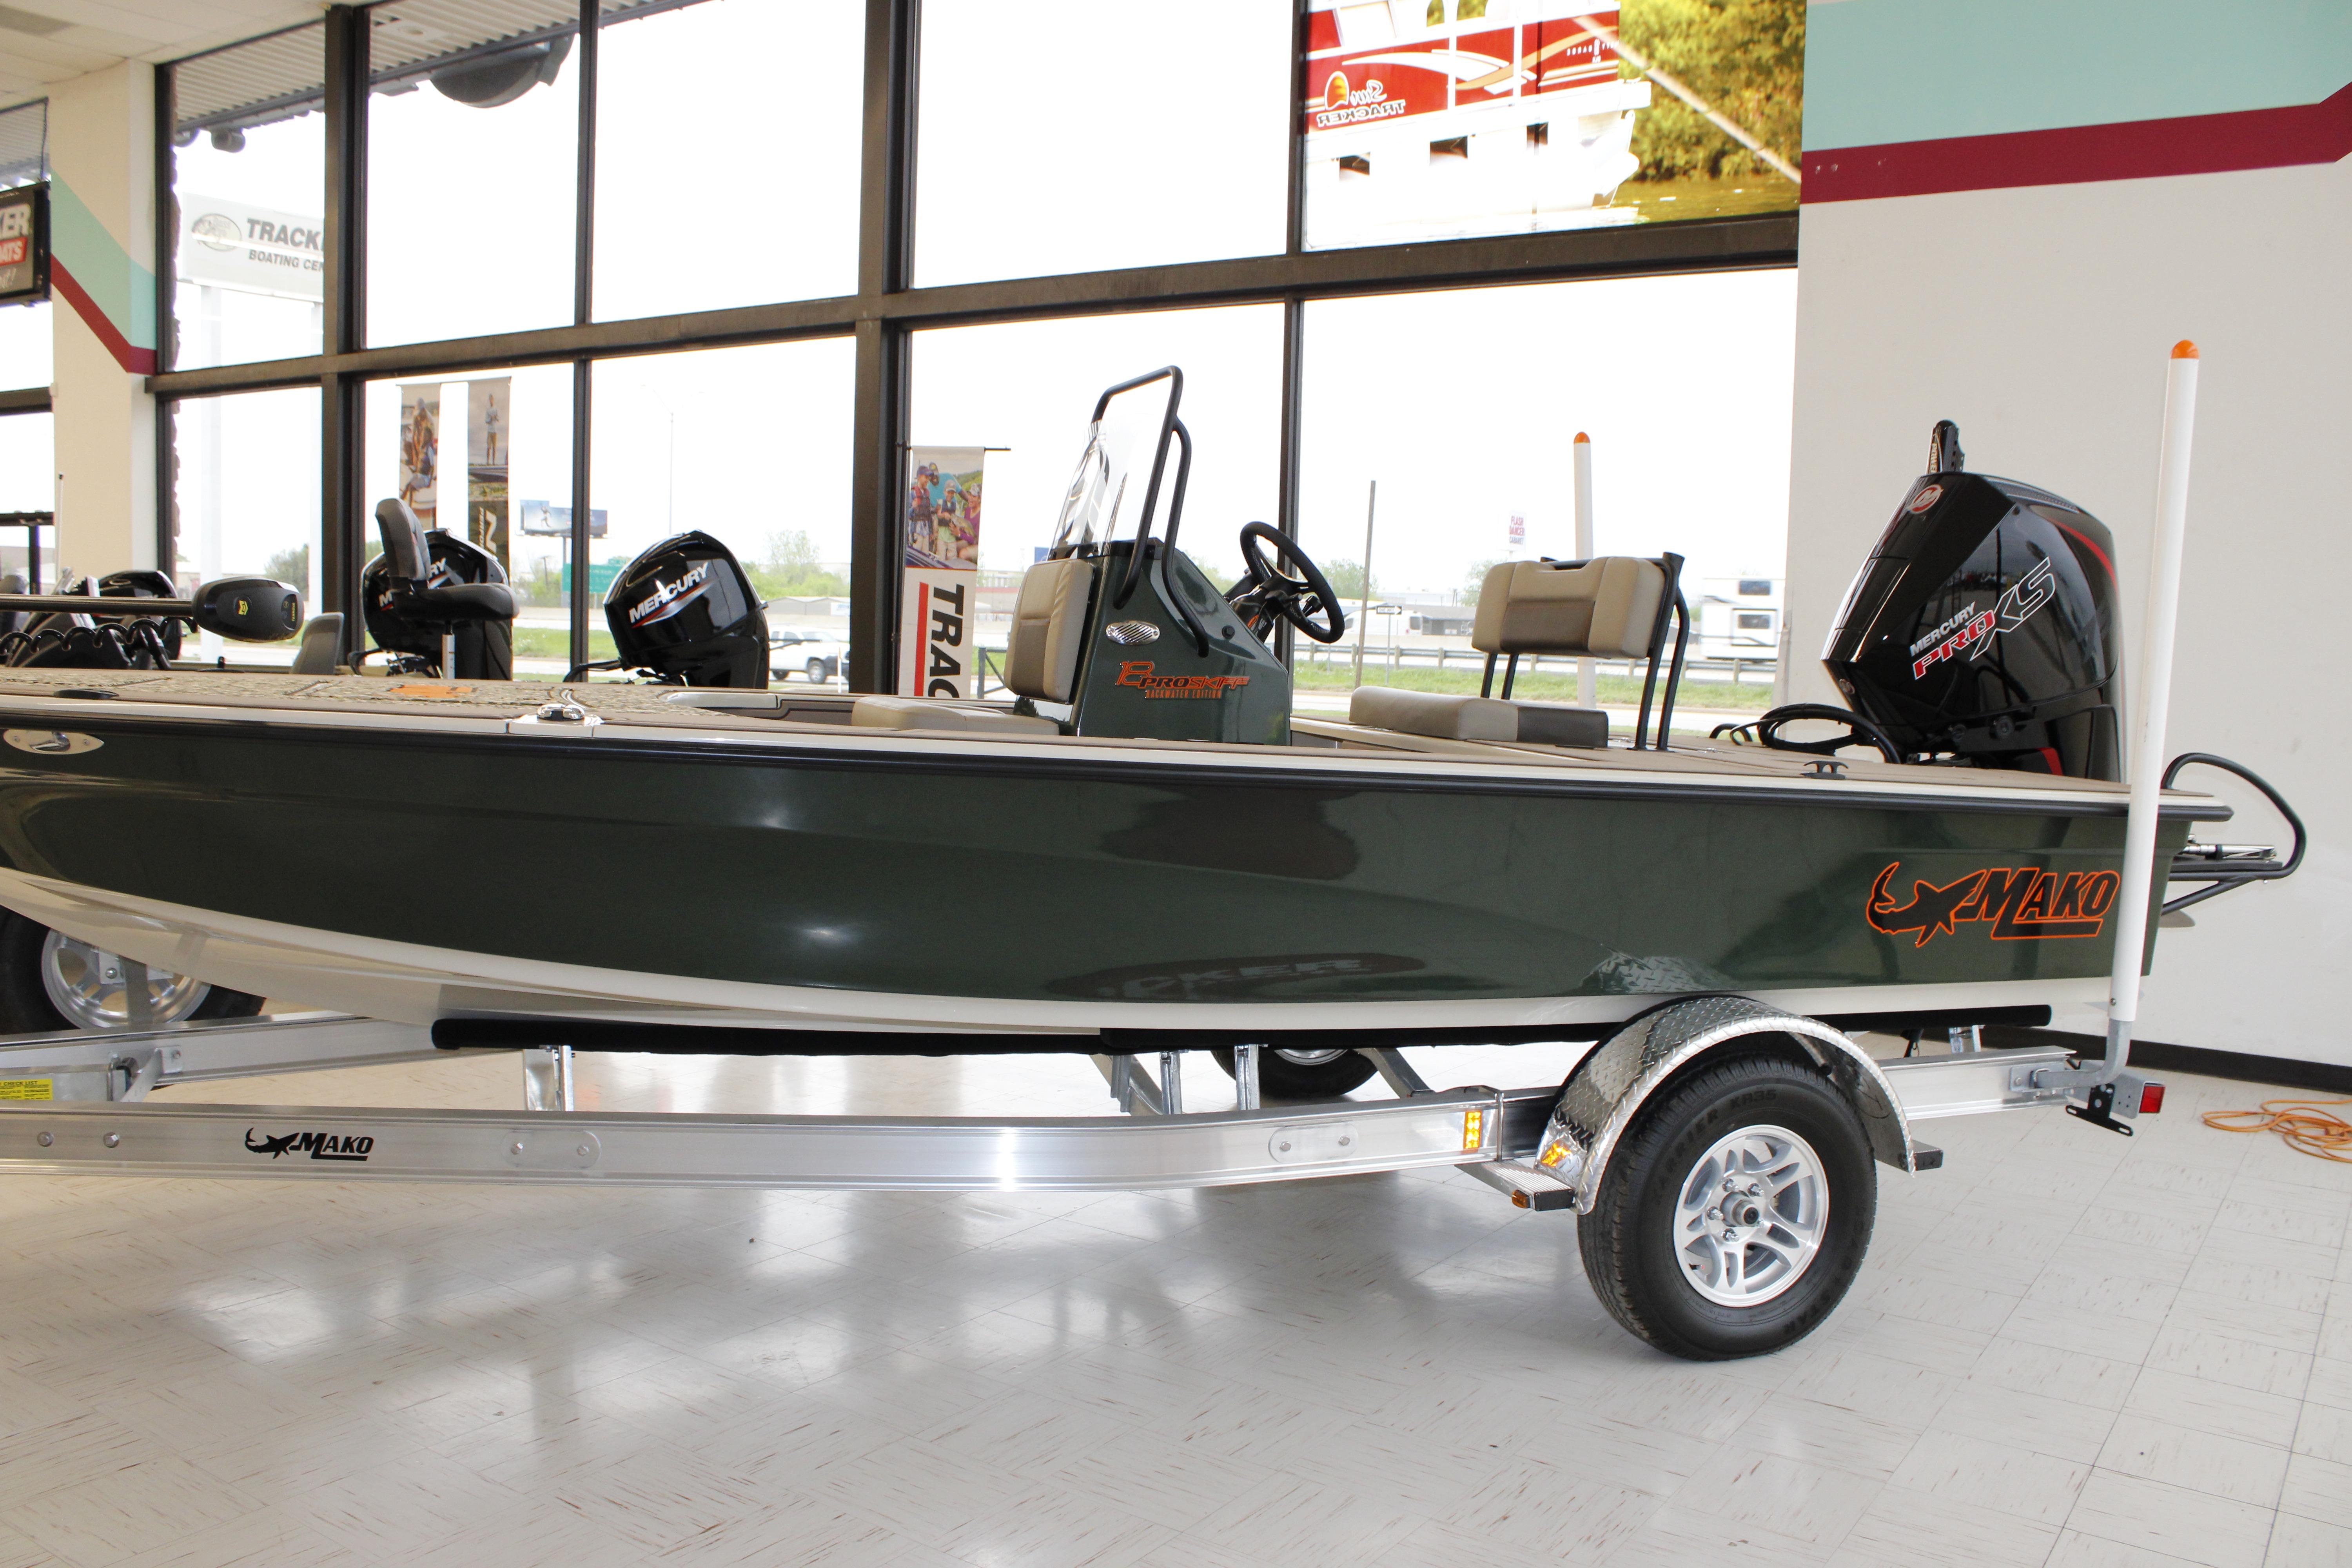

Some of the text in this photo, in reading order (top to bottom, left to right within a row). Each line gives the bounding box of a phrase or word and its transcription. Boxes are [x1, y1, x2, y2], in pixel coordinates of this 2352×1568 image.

[0, 204, 31, 238] ER
[247, 218, 324, 251] TRACK
[249, 250, 299, 268] BOATING
[1930, 443, 1938, 473] POWE
[628, 561, 708, 623] MERCURY
[1909, 601, 1976, 657] MERCURY
[1913, 556, 2055, 680] PRO XS
[1117, 661, 1154, 686] 18
[1146, 690, 1220, 699] BACKWATER EDITION
[1952, 867, 2121, 940] MAKO
[289, 1132, 374, 1161] MAKO
